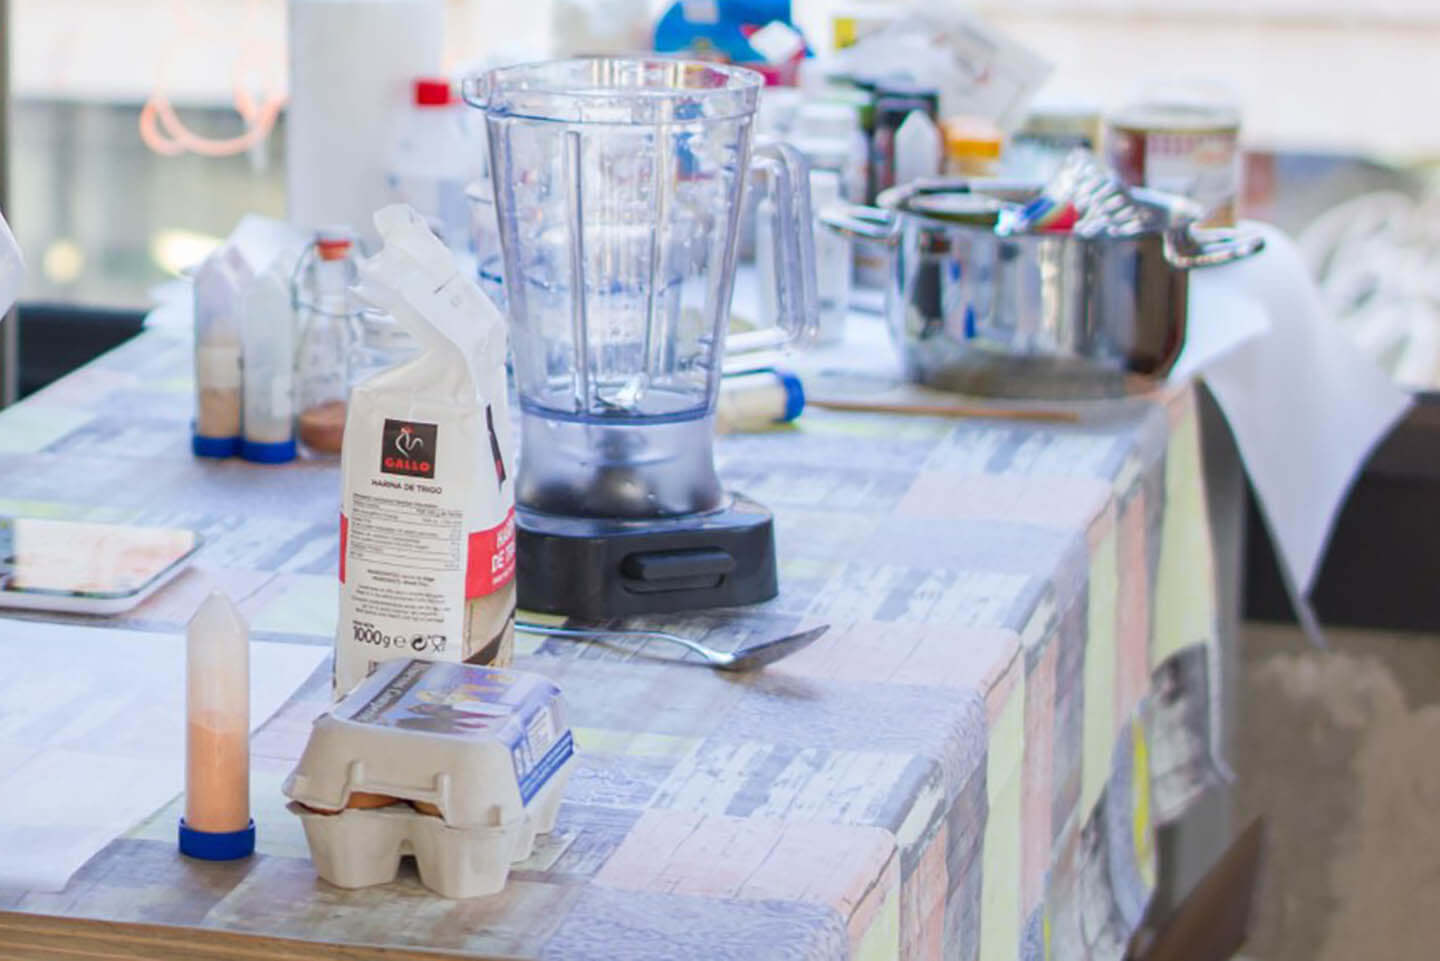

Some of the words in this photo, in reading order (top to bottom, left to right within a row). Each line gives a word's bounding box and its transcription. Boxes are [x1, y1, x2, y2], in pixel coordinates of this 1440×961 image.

[383, 457, 431, 473] GALLO
[371, 479, 402, 489] HARINA
[403, 483, 415, 491] DE
[416, 484, 443, 495] TRIGO
